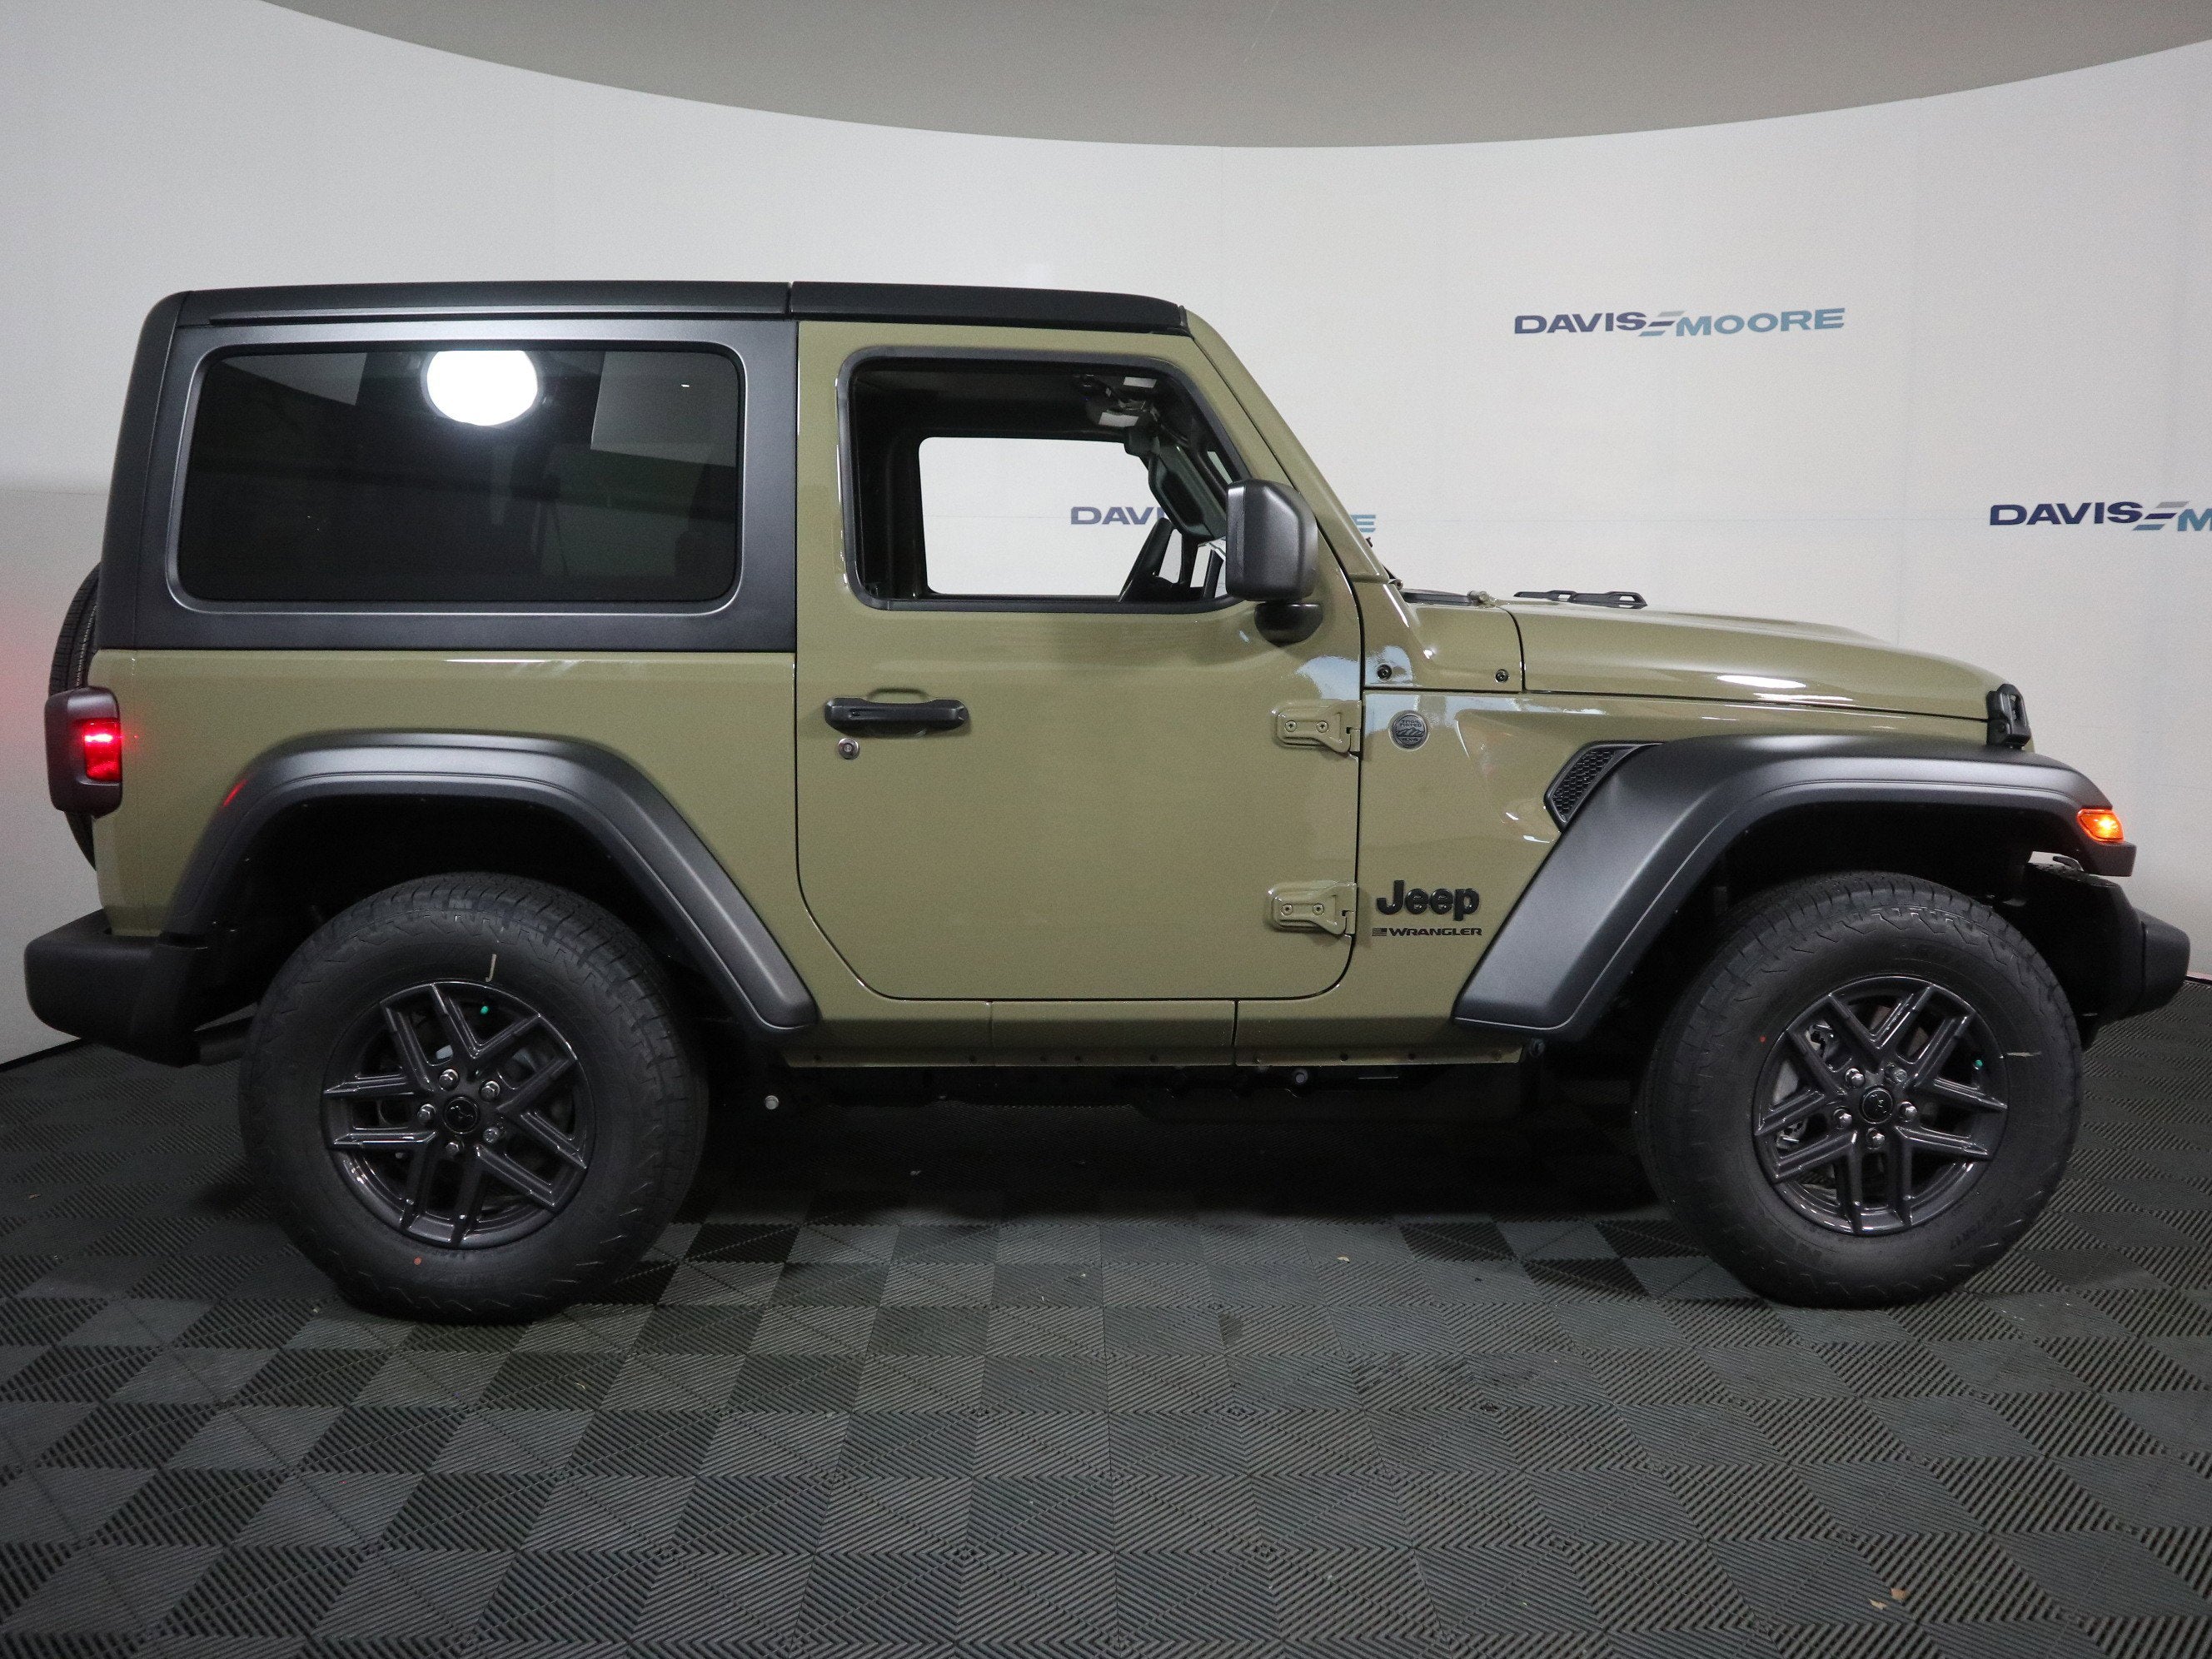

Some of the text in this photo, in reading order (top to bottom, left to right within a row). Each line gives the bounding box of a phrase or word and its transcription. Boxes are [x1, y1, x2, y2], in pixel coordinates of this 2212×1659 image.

[1514, 307, 1846, 336] DAVIS MOORE
[1990, 501, 2144, 526] DAVIS
[1377, 879, 1480, 921] Jeep
[1388, 927, 1482, 936] WRANGLER
